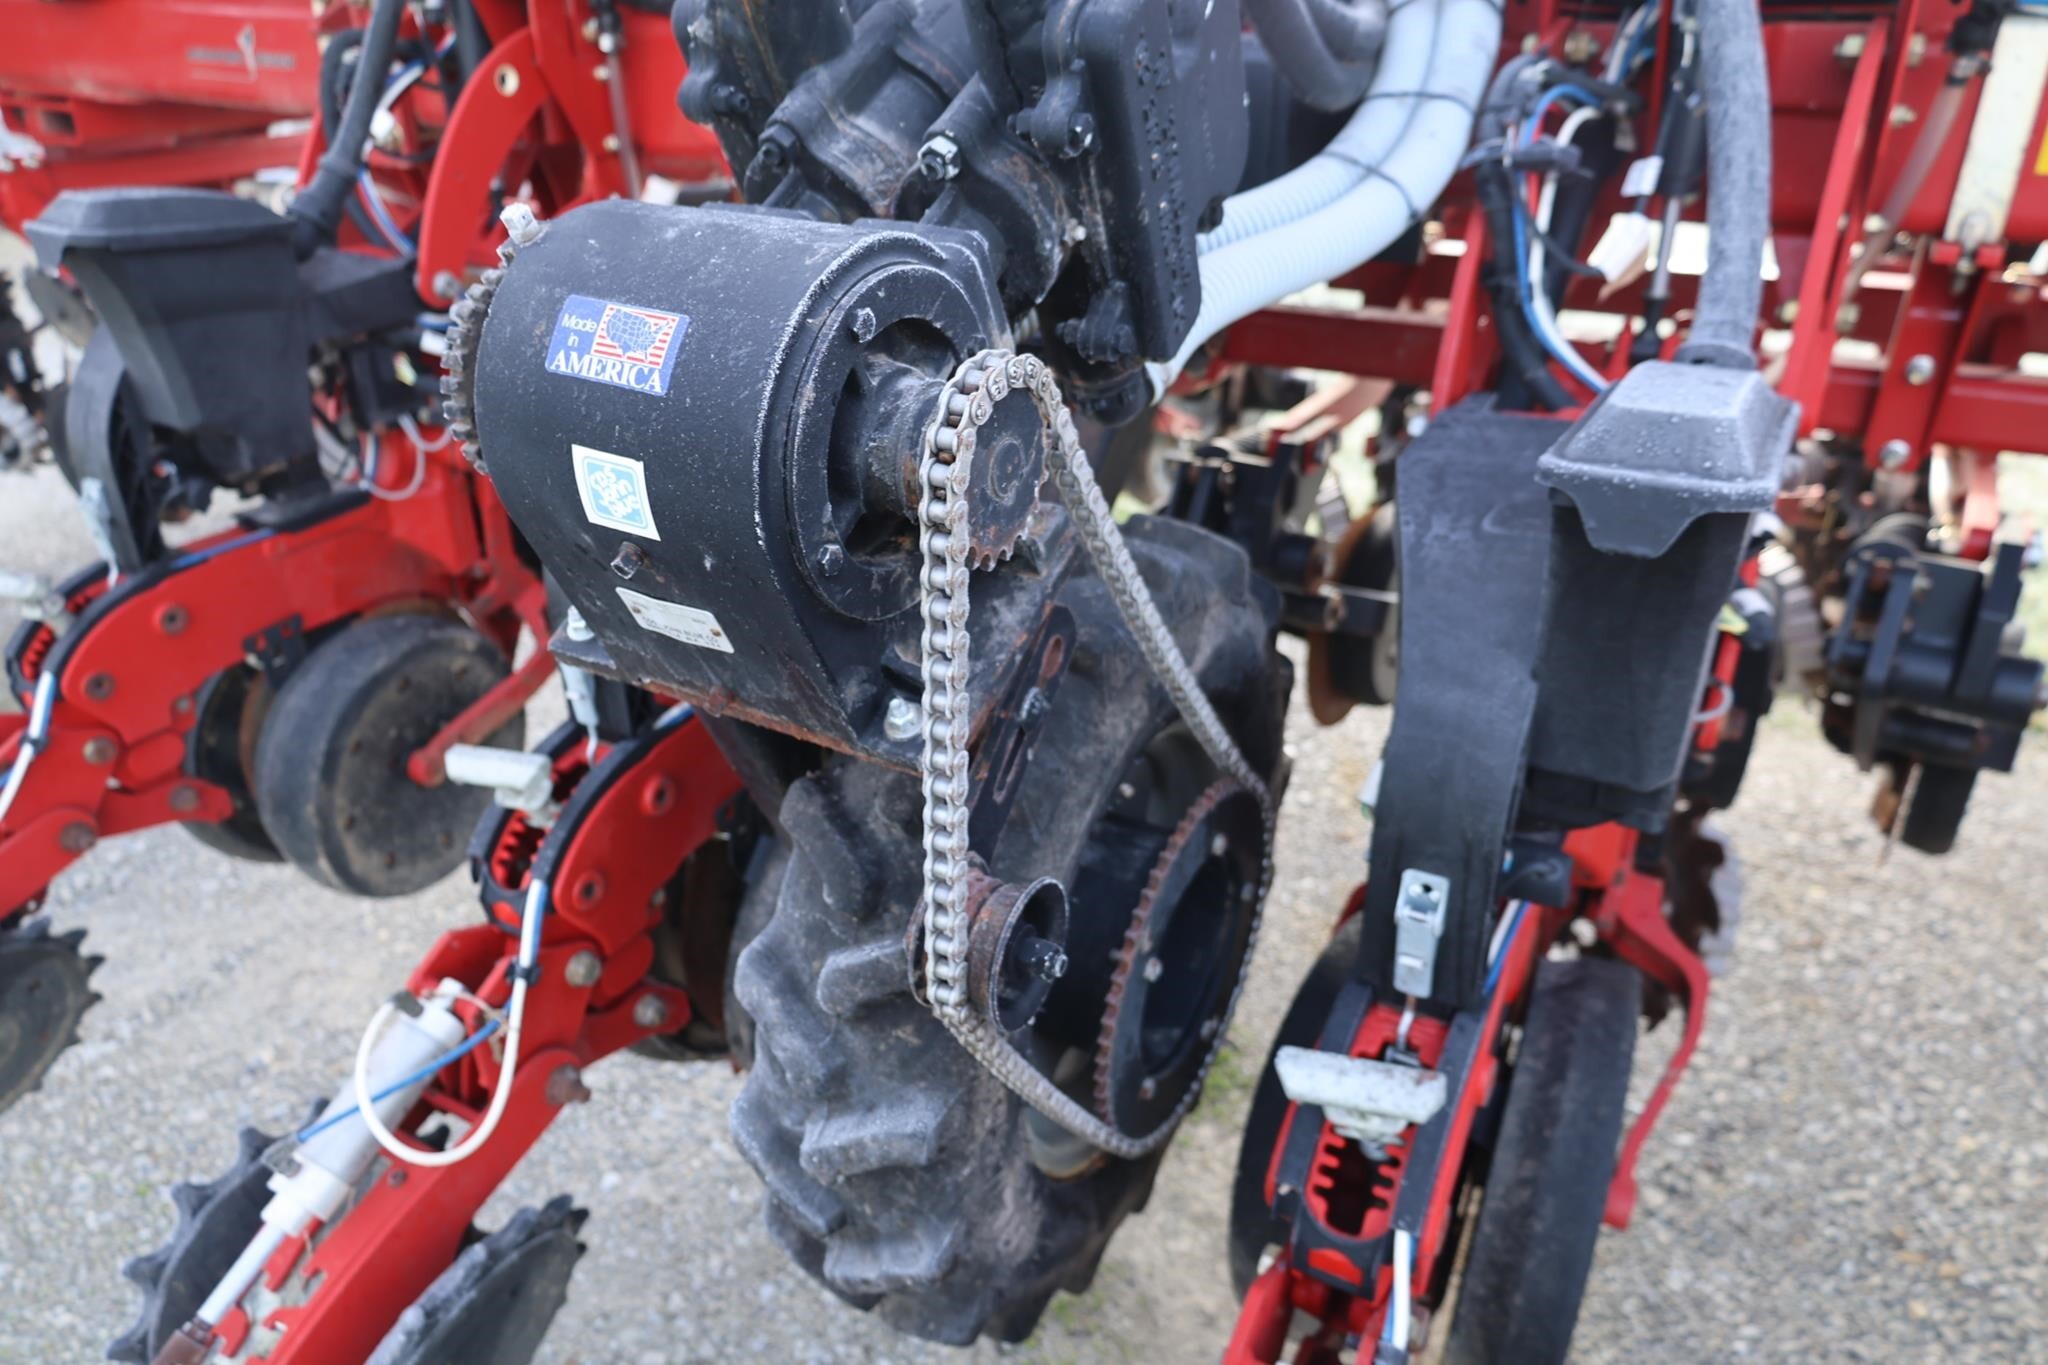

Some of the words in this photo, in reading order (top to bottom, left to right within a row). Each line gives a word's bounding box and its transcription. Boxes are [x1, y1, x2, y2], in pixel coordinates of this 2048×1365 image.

[561, 313, 597, 333] Made
[567, 333, 579, 347] in
[550, 350, 662, 392] AMERICA
